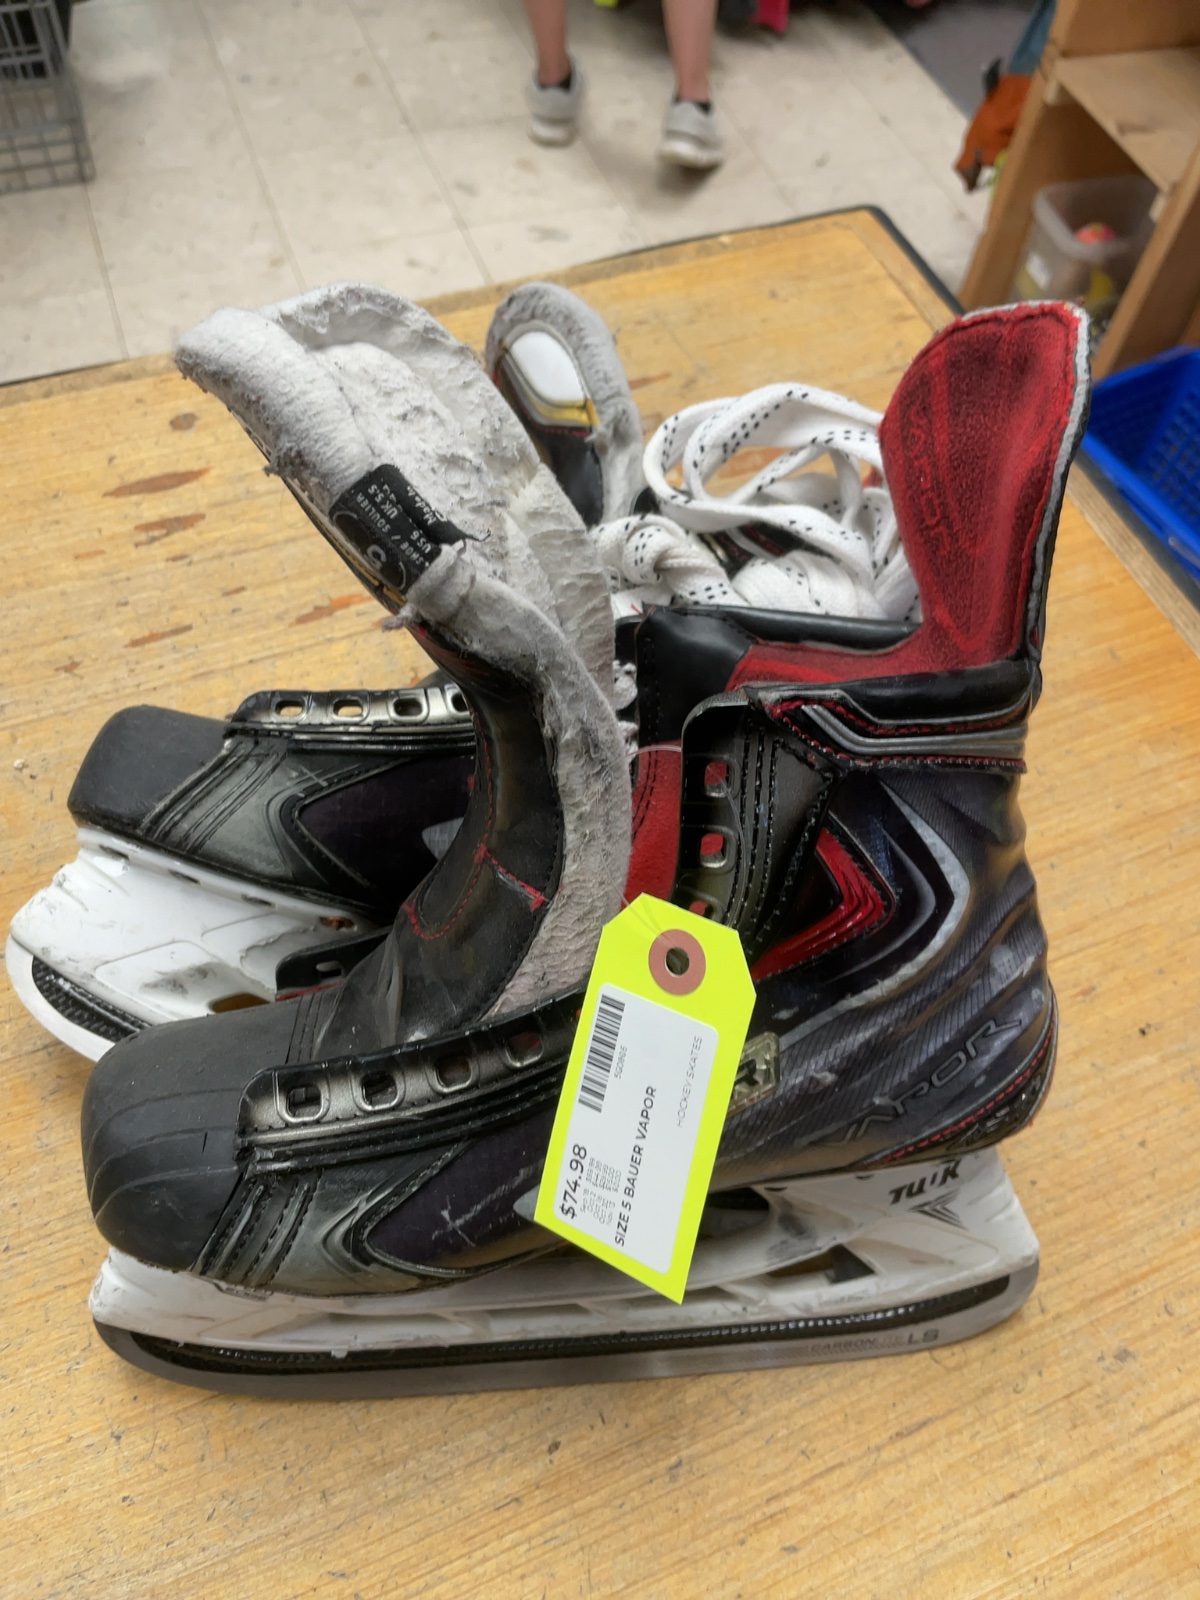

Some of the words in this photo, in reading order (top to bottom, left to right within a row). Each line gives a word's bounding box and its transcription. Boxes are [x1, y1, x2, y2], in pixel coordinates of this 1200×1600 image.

[367, 484, 385, 503] 5.5
[356, 492, 391, 533] SOULIER
[381, 499, 398, 519] UK
[410, 530, 420, 541] 6
[417, 537, 432, 554] US
[400, 541, 424, 565] SHOE
[677, 1079, 692, 1128] HOCKEY
[686, 1036, 702, 1080] SKATES
[636, 1086, 656, 1140] VAPOR
[559, 1144, 587, 1219] $74.98
[624, 1145, 644, 1199] BAUER
[621, 1201, 632, 1212] 5
[614, 1213, 630, 1247] SIZE
